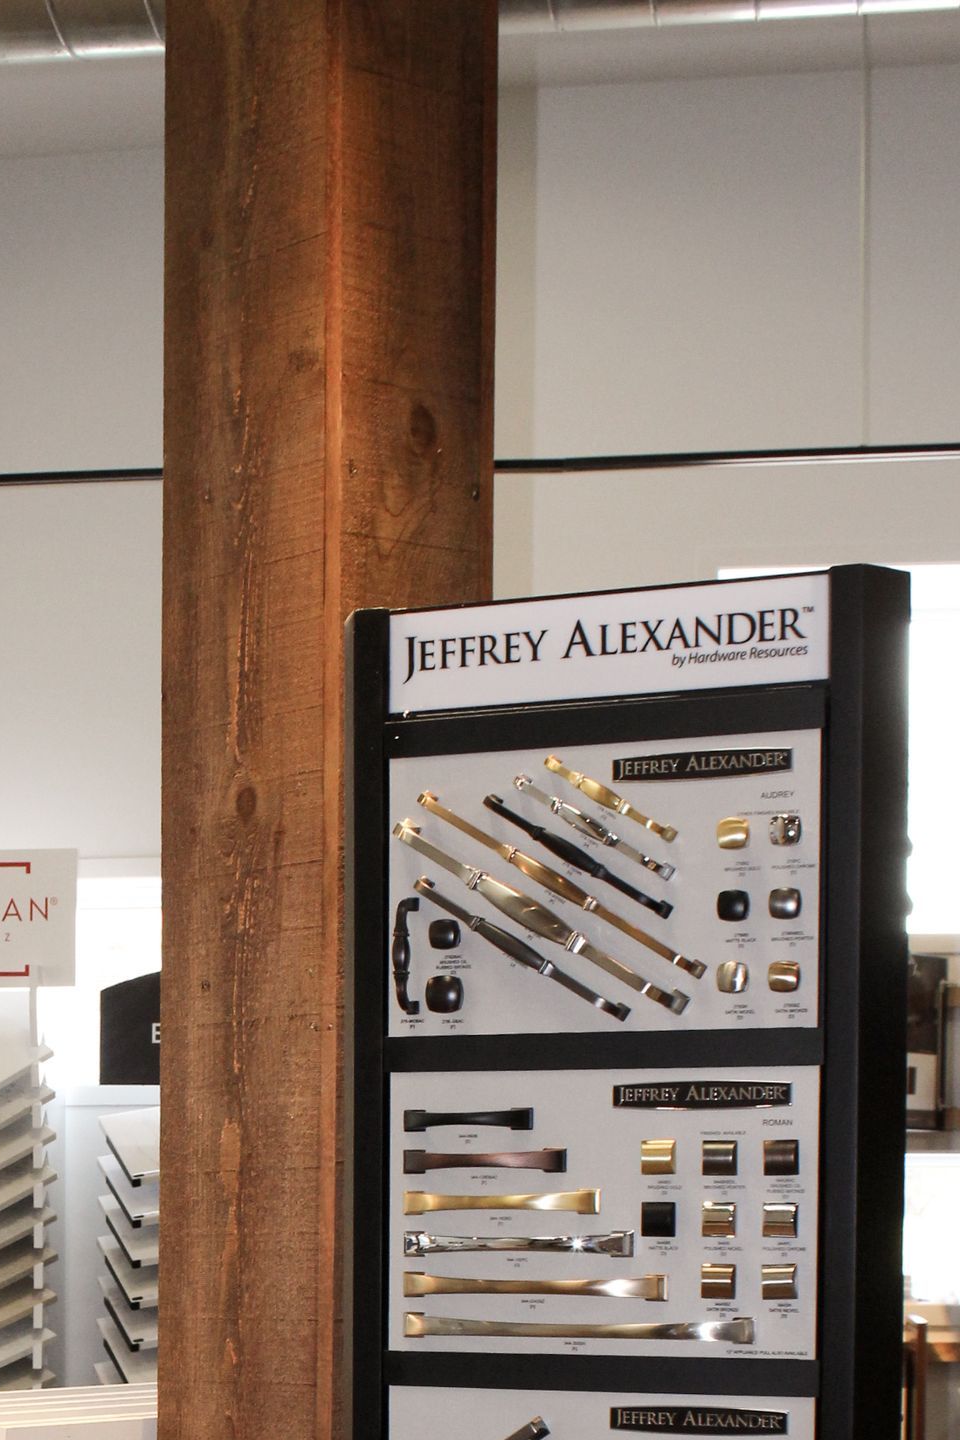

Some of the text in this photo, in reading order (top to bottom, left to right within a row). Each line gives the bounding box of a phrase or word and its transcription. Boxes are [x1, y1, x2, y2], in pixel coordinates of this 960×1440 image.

[403, 629, 549, 685] JEFFREY
[671, 644, 809, 669] by Hardware Resources
[618, 758, 680, 780] JEFFREY
[761, 789, 796, 800] AUDREY
[619, 1086, 680, 1105] JEFFREY
[762, 1118, 793, 1127] ROMAN
[617, 1408, 677, 1427] JEFFREY
